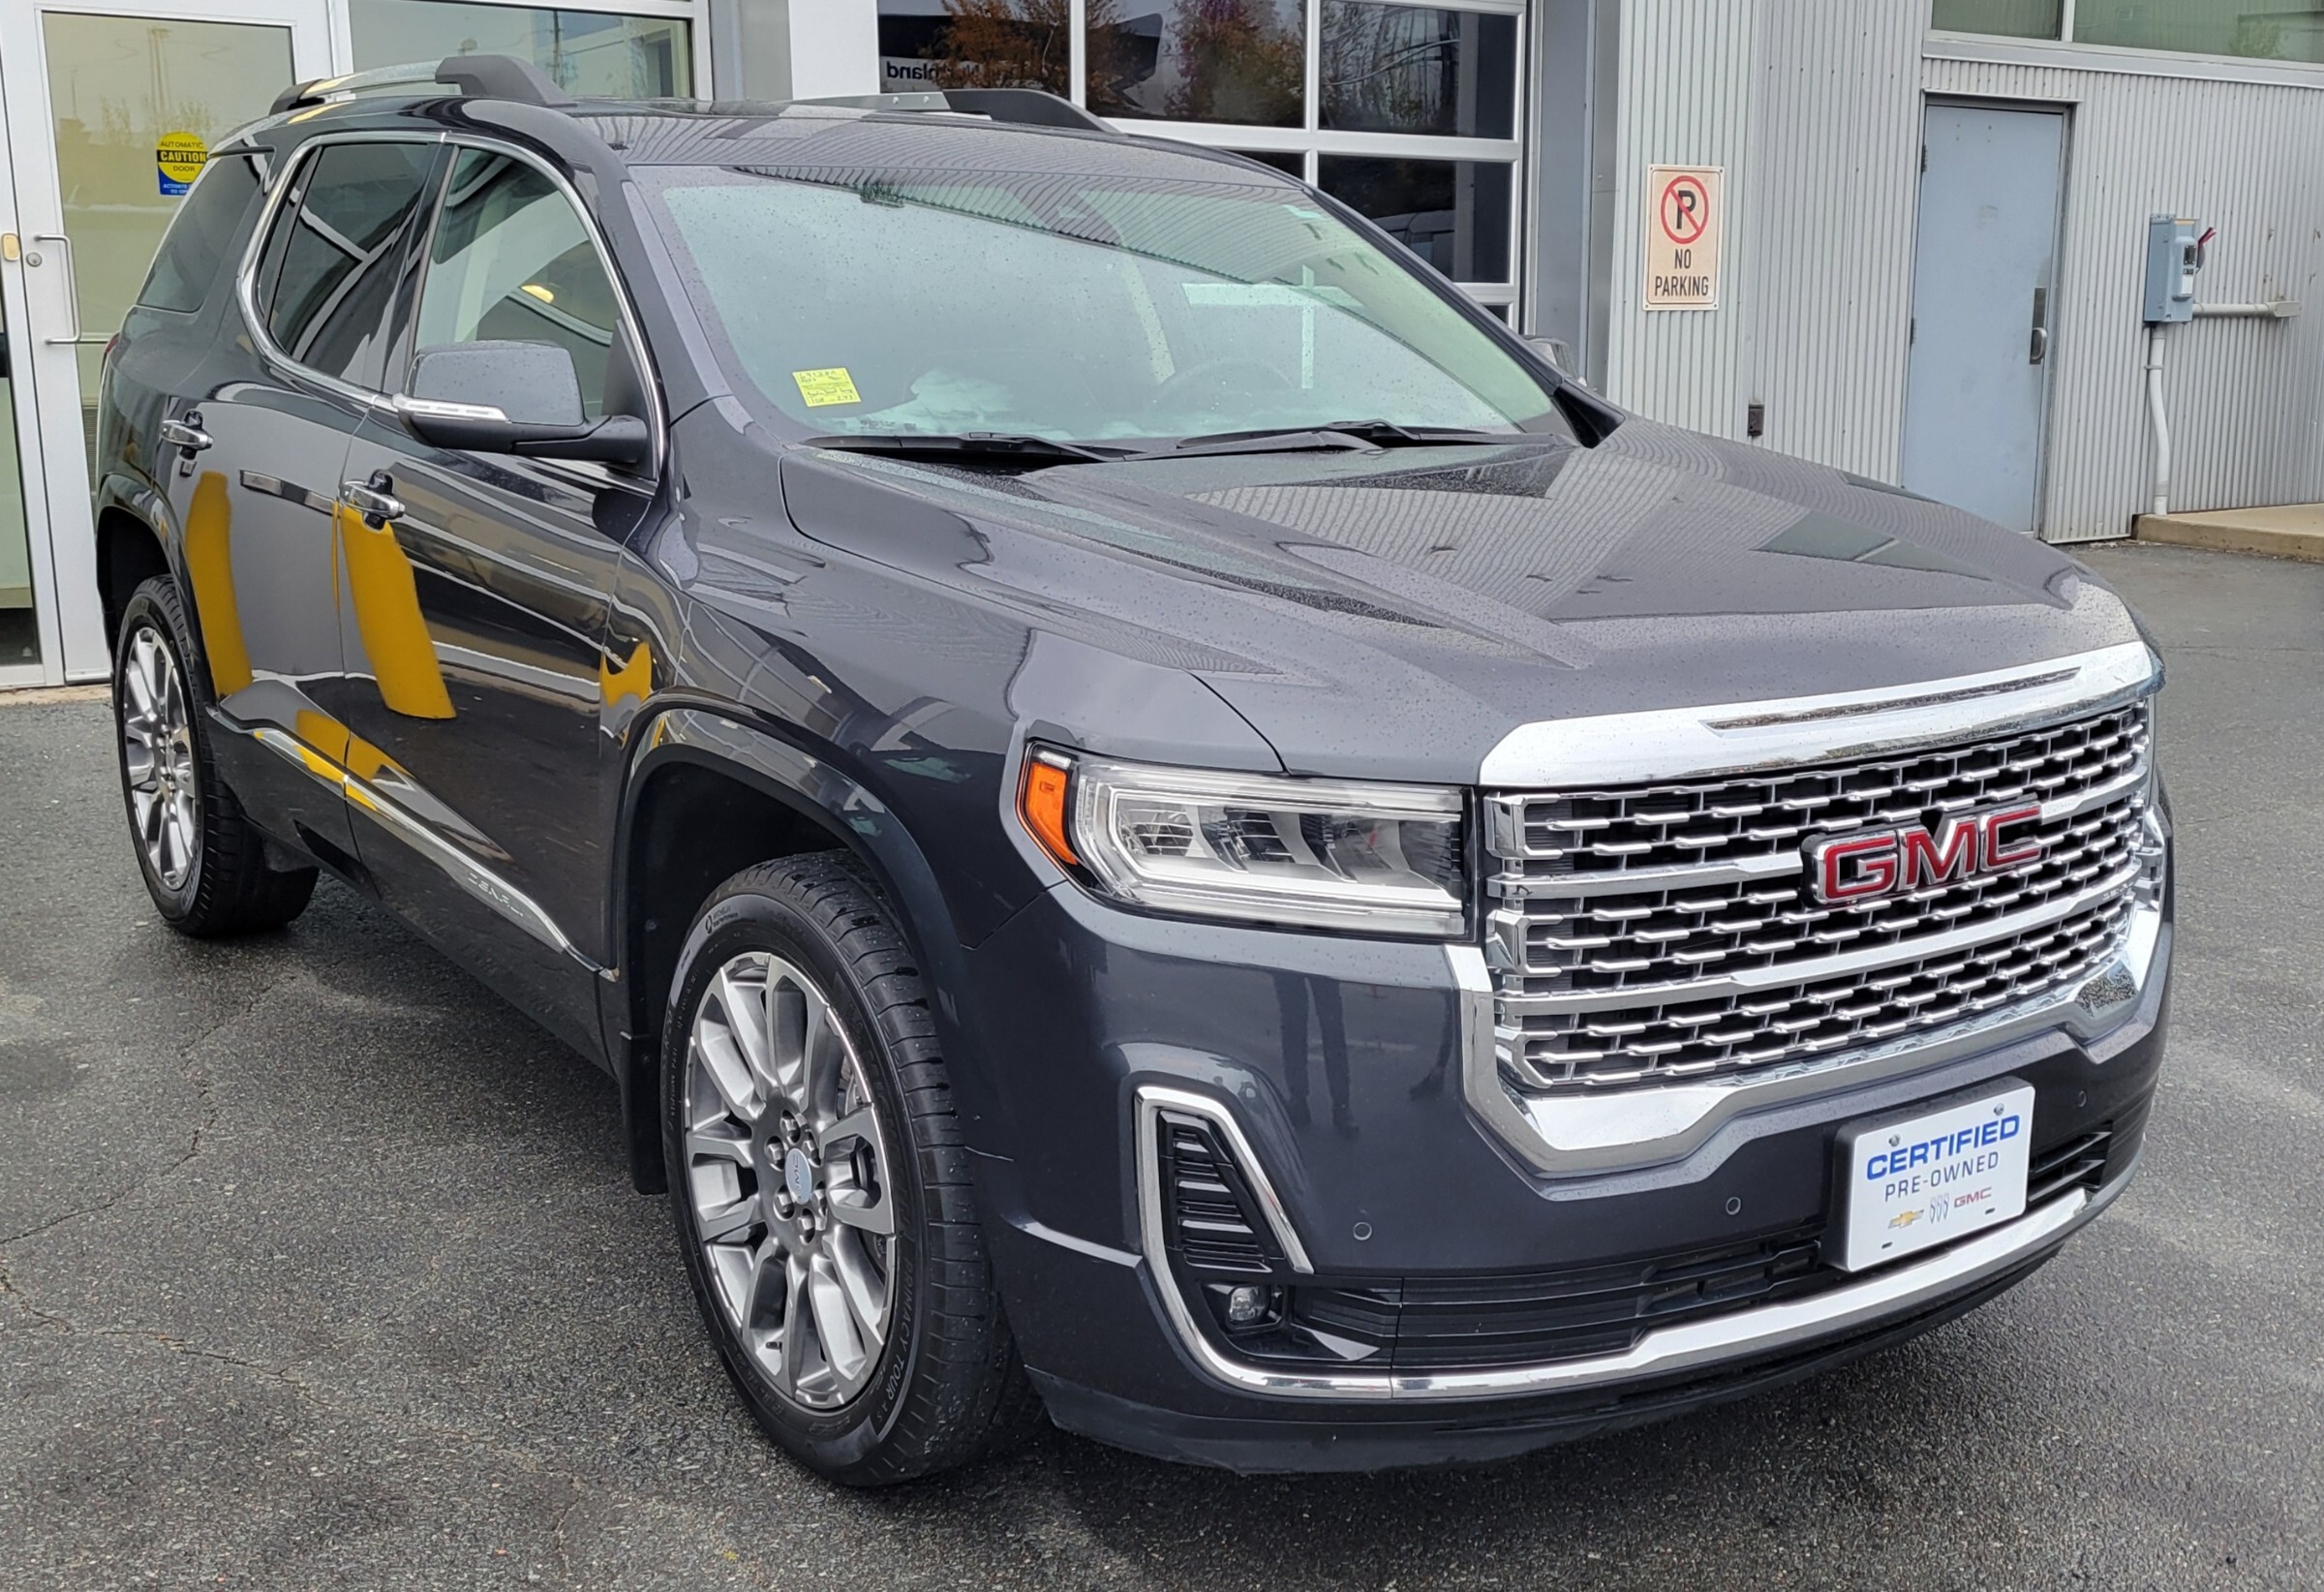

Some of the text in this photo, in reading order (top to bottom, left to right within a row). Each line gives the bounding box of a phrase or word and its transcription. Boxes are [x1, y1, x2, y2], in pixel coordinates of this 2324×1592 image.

[160, 140, 203, 149] AUTOMATIC
[160, 150, 207, 163] CAUTION
[1674, 249, 1692, 269] NO
[1654, 275, 1709, 297] PARKING
[1817, 801, 2041, 903] GMC
[1866, 1115, 2020, 1180] CERTIFIED
[1884, 1150, 1999, 1203] PRE-OWNED
[1953, 1186, 1993, 1209] GMC
[900, 1257, 914, 1352] PRIMACY
[885, 1354, 905, 1401] TOUR
